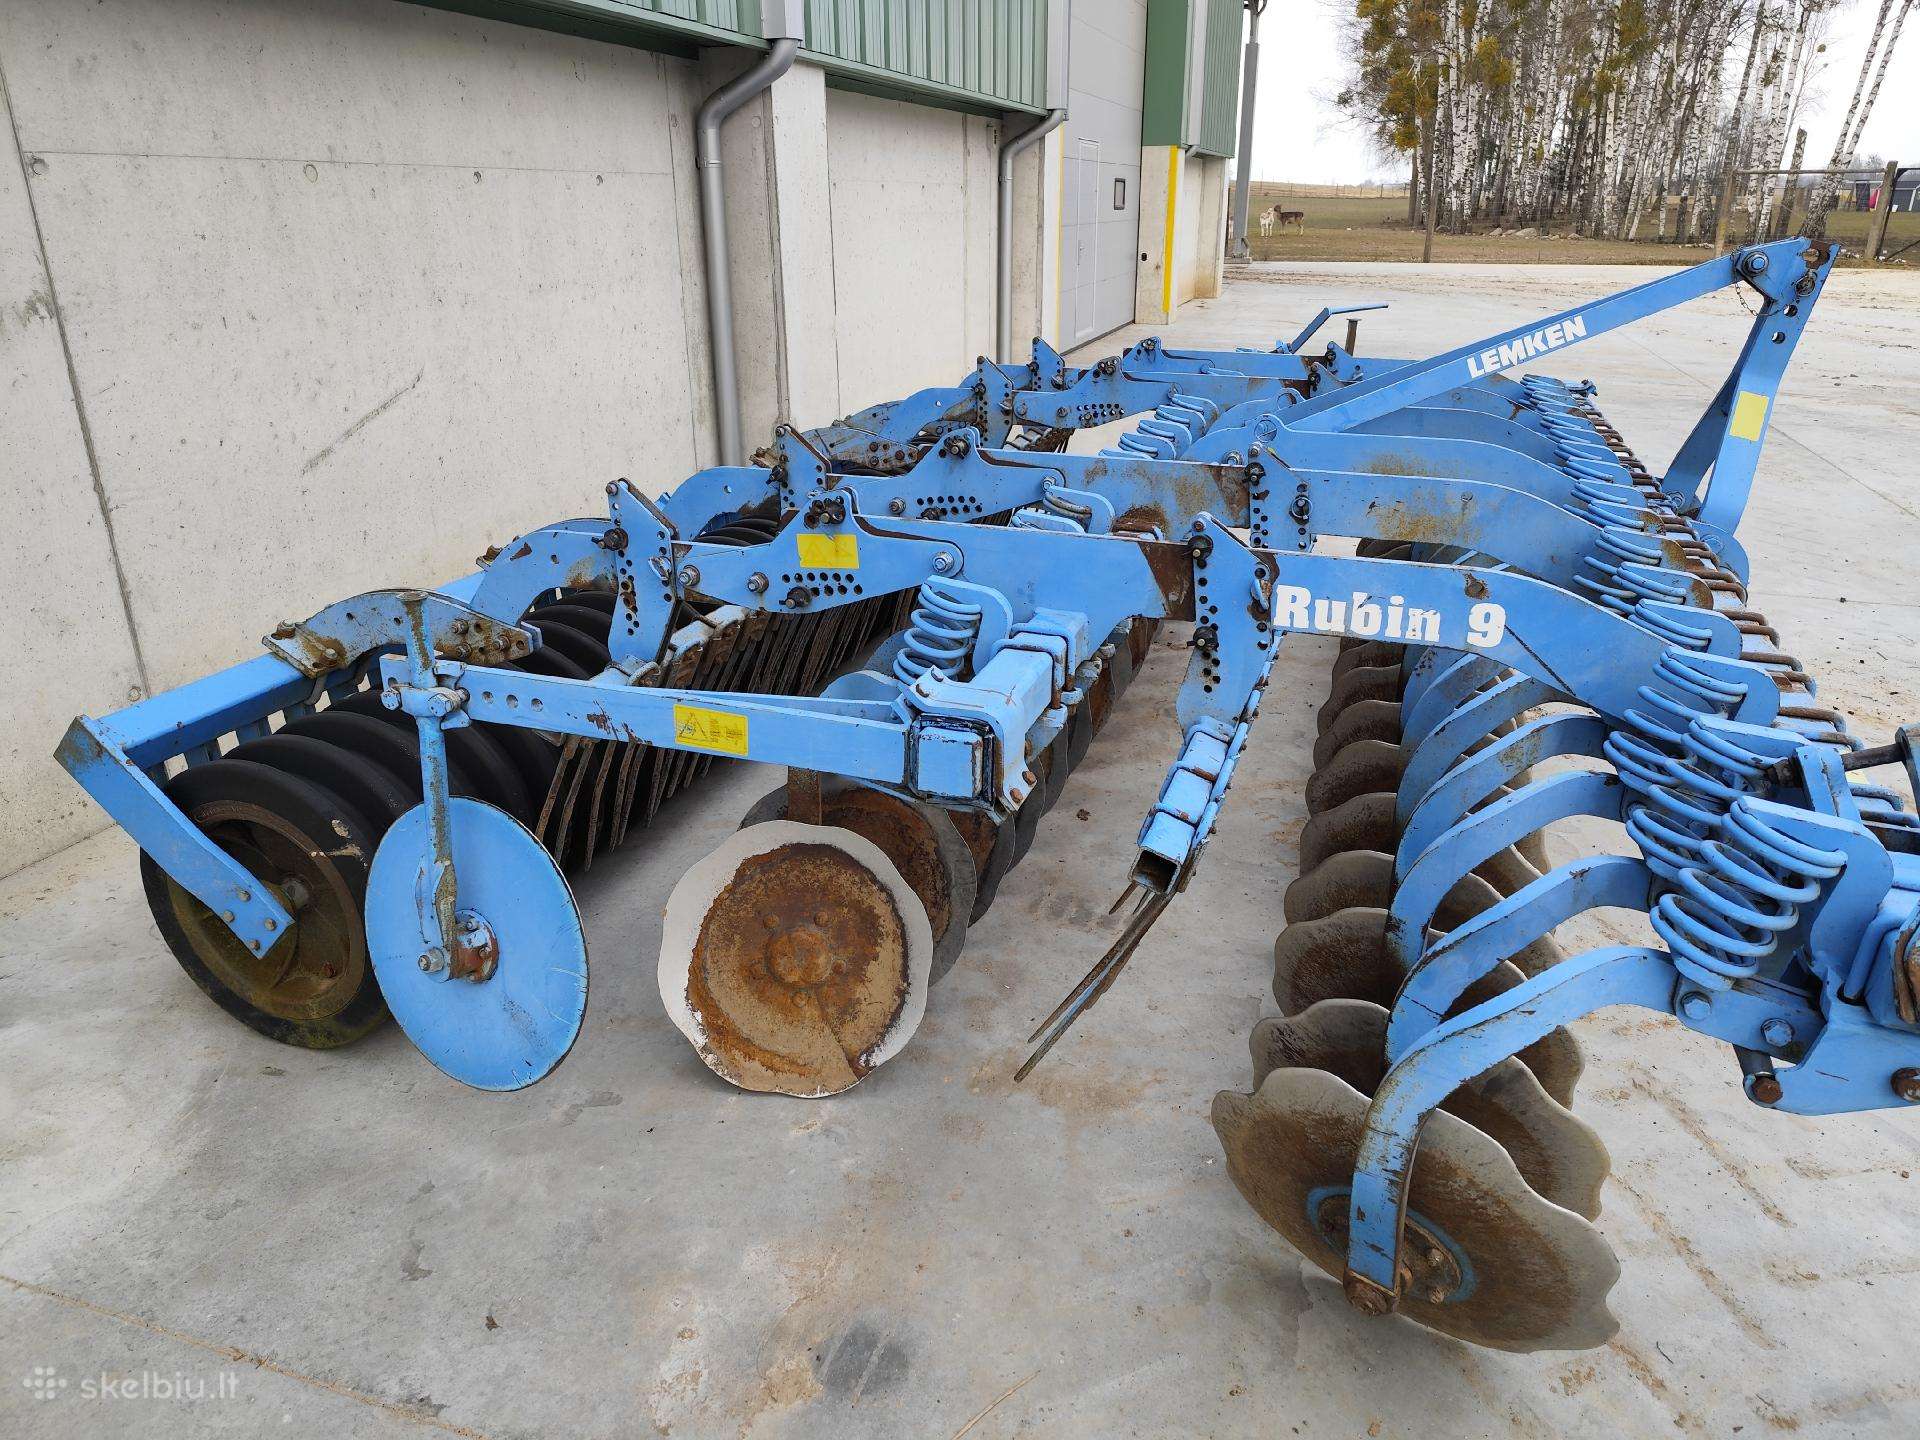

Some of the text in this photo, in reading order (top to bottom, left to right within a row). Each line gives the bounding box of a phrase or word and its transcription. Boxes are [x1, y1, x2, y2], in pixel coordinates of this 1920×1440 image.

[1466, 315, 1587, 379] LEMKEN
[1273, 585, 1506, 648] Rubin 9
